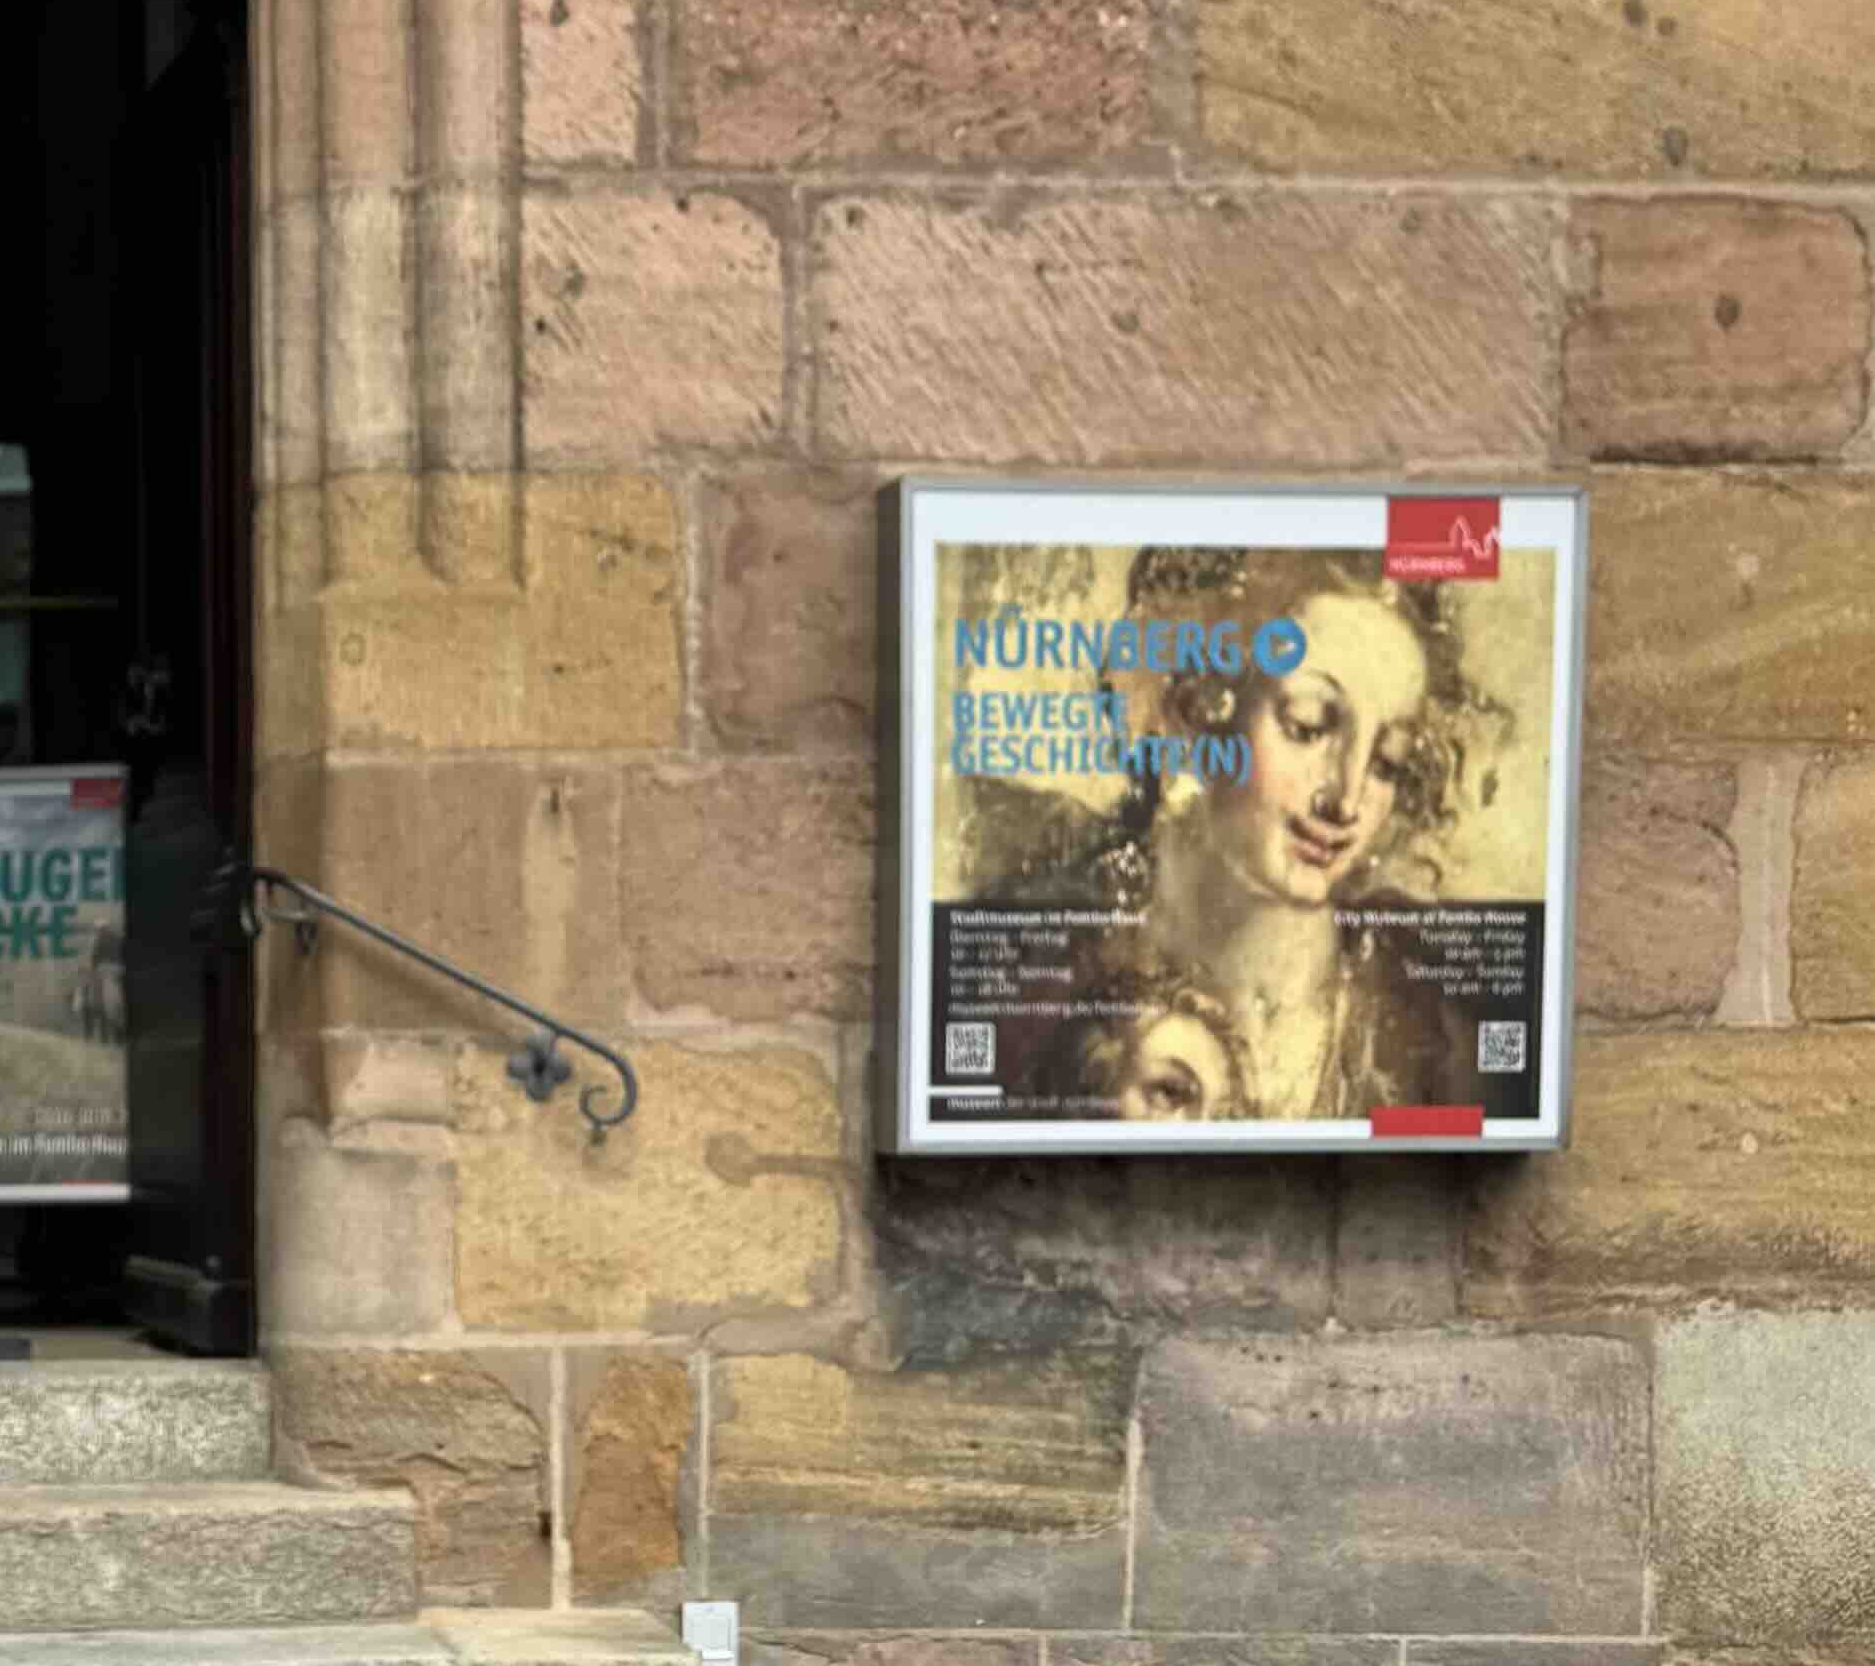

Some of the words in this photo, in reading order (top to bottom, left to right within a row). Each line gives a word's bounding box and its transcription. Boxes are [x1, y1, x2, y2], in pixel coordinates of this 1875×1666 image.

[954, 603, 1244, 676] NÜRNBERG
[952, 690, 1127, 733] BEWEGTE
[951, 731, 1254, 788] GESCHICHTE(N)
